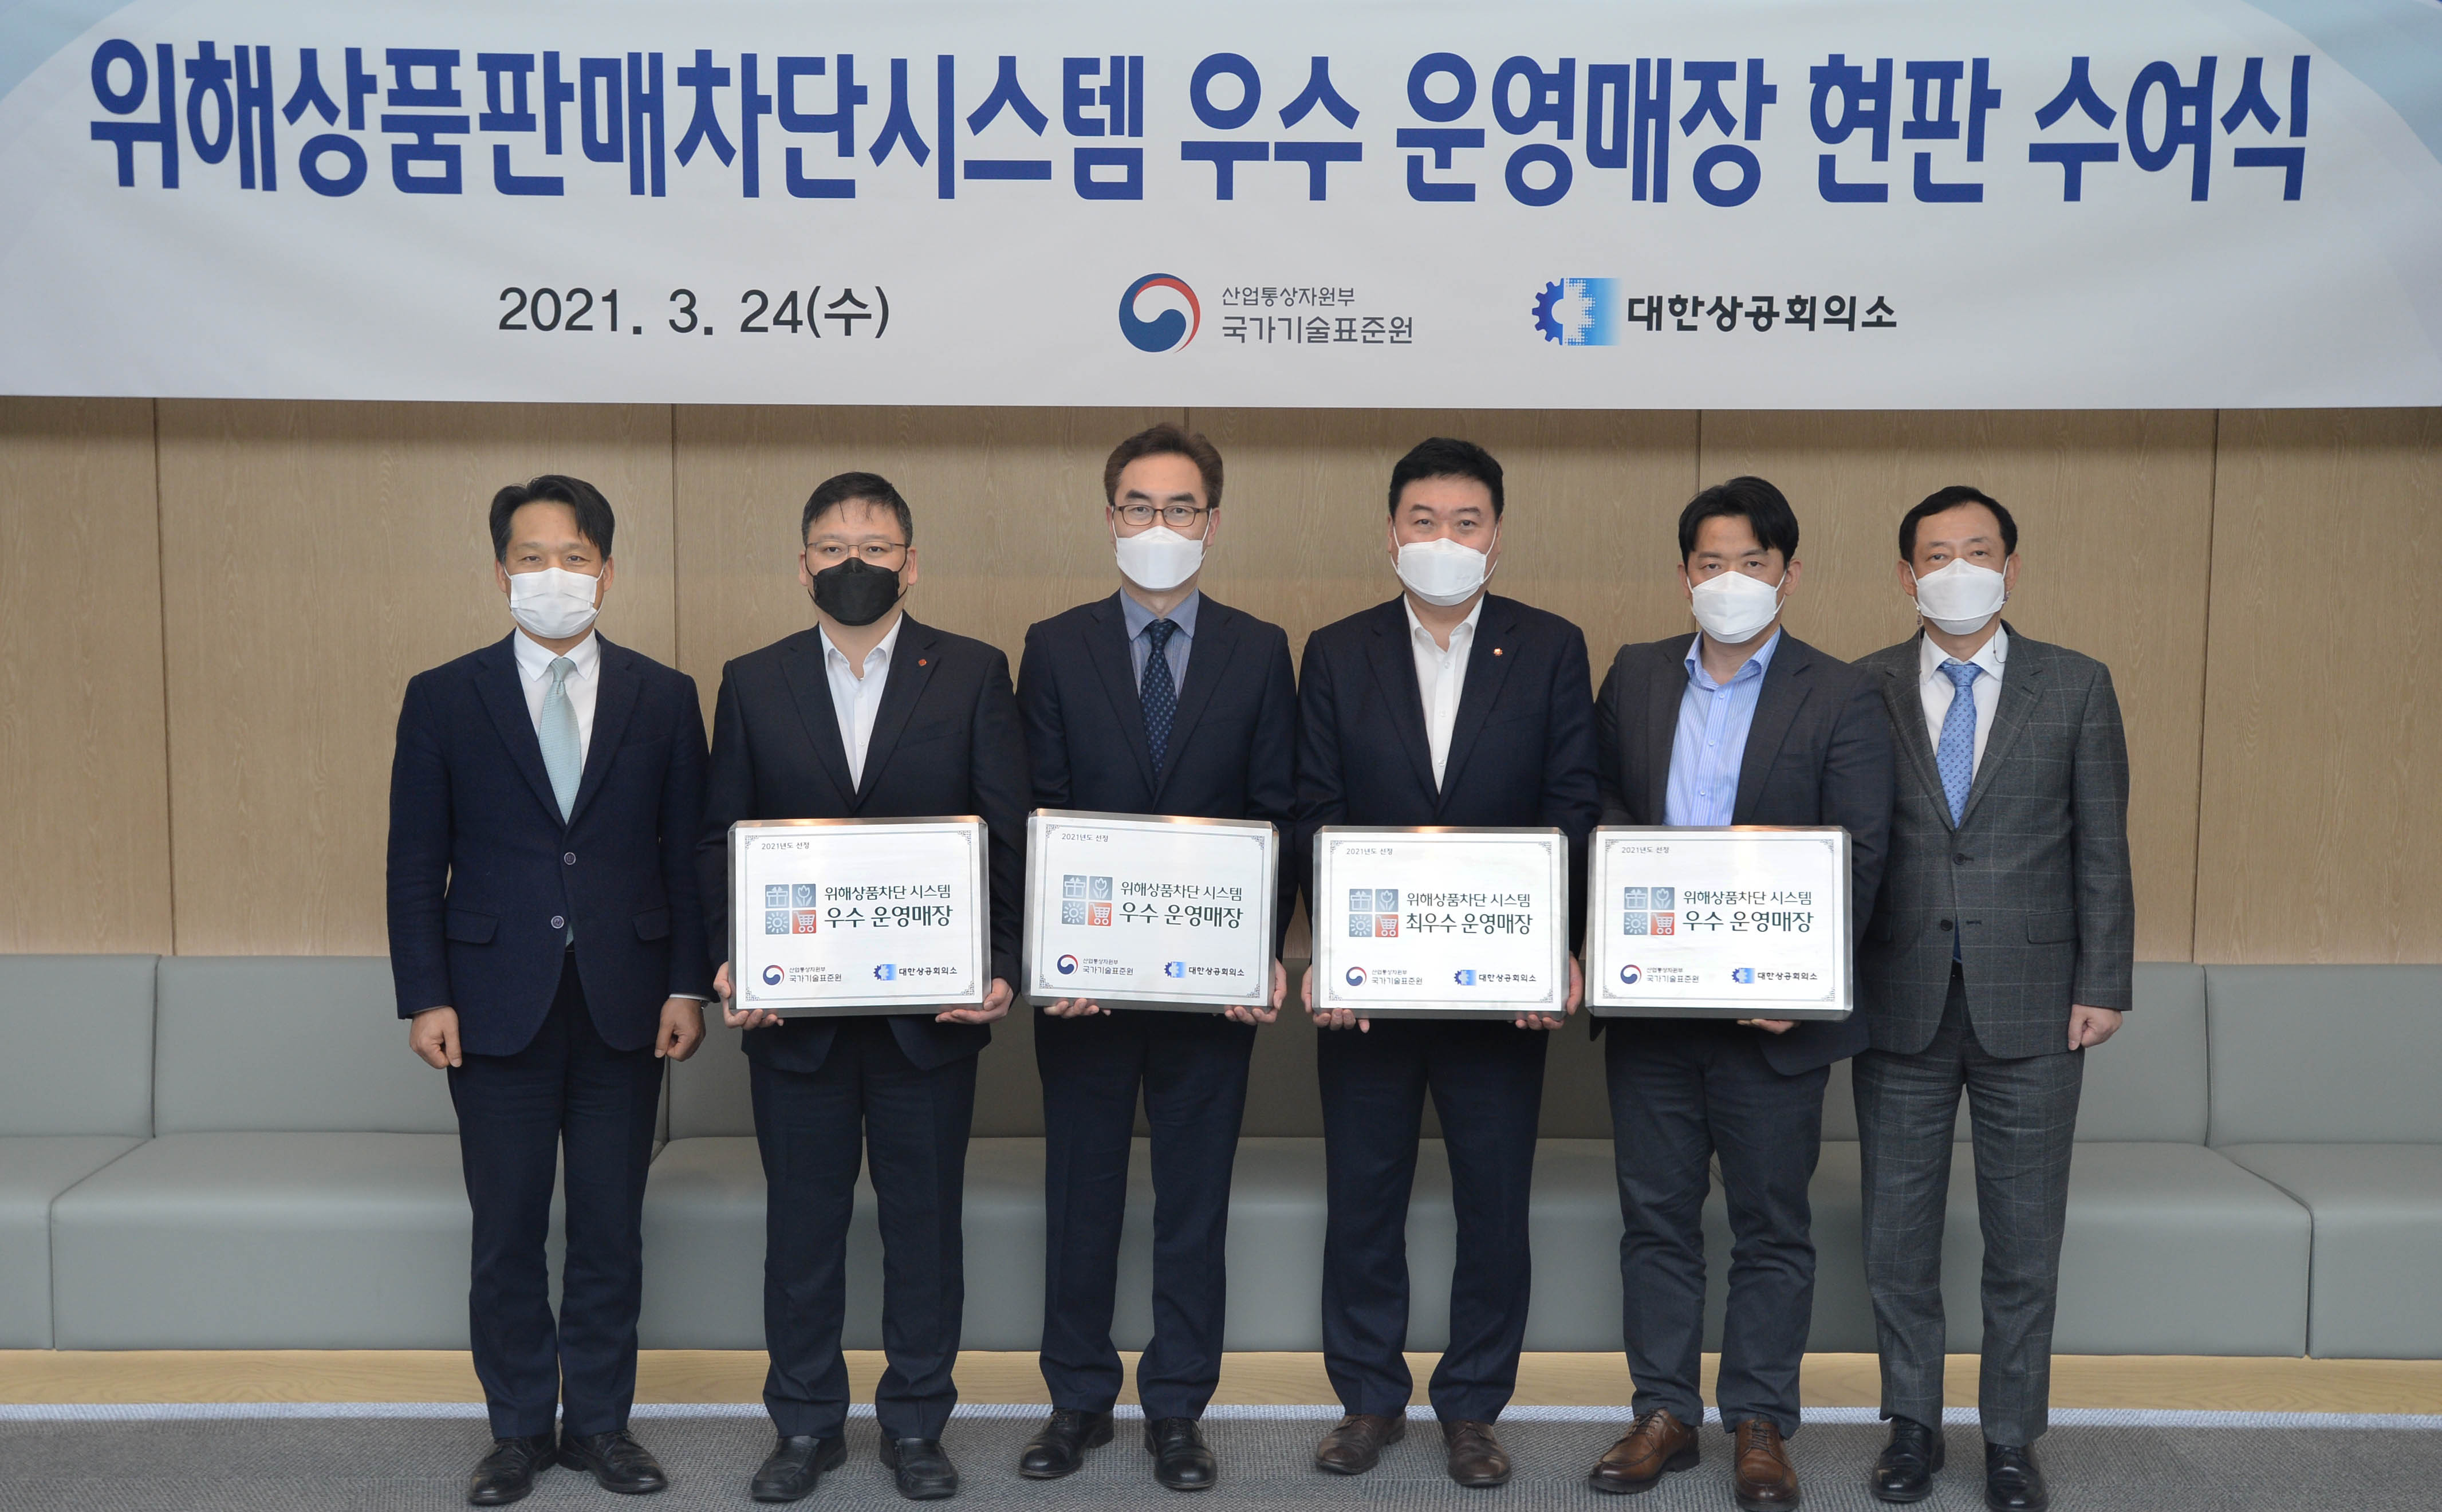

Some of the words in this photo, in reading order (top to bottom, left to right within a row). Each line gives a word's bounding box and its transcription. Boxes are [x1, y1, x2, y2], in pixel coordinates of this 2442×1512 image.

[90, 38, 1144, 200] 위해상품판매차단시스템
[1180, 52, 1363, 201] 우수
[1396, 52, 1778, 208] 운영매장
[1809, 53, 2002, 203] 현판
[2028, 54, 2311, 202] 수여식
[1222, 286, 1355, 307] 산업통상자원부
[499, 286, 642, 335] 2021.
[668, 288, 713, 336] 3.
[740, 285, 889, 339] 24(수)
[1628, 294, 1897, 332] 대한상공회의소
[1222, 316, 1412, 344] 국가기술표준원
[1061, 833, 1093, 841] 2021년도
[1096, 834, 1109, 842] 선정
[796, 841, 810, 849] 선정
[1380, 848, 1393, 856] 선정
[824, 885, 907, 901] 위해상품차단
[910, 884, 951, 899] 시스템
[1120, 881, 1200, 899] 위해상품차단
[1203, 886, 1242, 901] 시스템
[1683, 891, 1767, 905] 위해상품차단
[1770, 891, 1811, 905] 시스템
[1407, 893, 1487, 907] 위해상품차단
[1490, 893, 1530, 908] 시스템
[824, 907, 865, 928] 우수
[871, 905, 954, 928] 운영매장
[1119, 901, 1159, 924] 우수
[1164, 904, 1244, 929] 운영매장
[1682, 911, 1724, 931] 우수
[1730, 911, 1814, 933] 운영매장
[1406, 912, 1458, 934] 최우수
[1461, 913, 1533, 935] 운영매장
[789, 973, 842, 983] 국가기술표준원
[899, 966, 958, 976] 대한상공회의소
[1082, 966, 1133, 976] 국가기술표준원
[1188, 966, 1244, 976] 대한상공회의소
[1479, 974, 1537, 982] 대한상공회의소
[1757, 972, 1818, 981] 대한상공회의소
[1372, 976, 1423, 985] 국가기술표준원
[1647, 975, 1699, 983] 국가기술표준원
